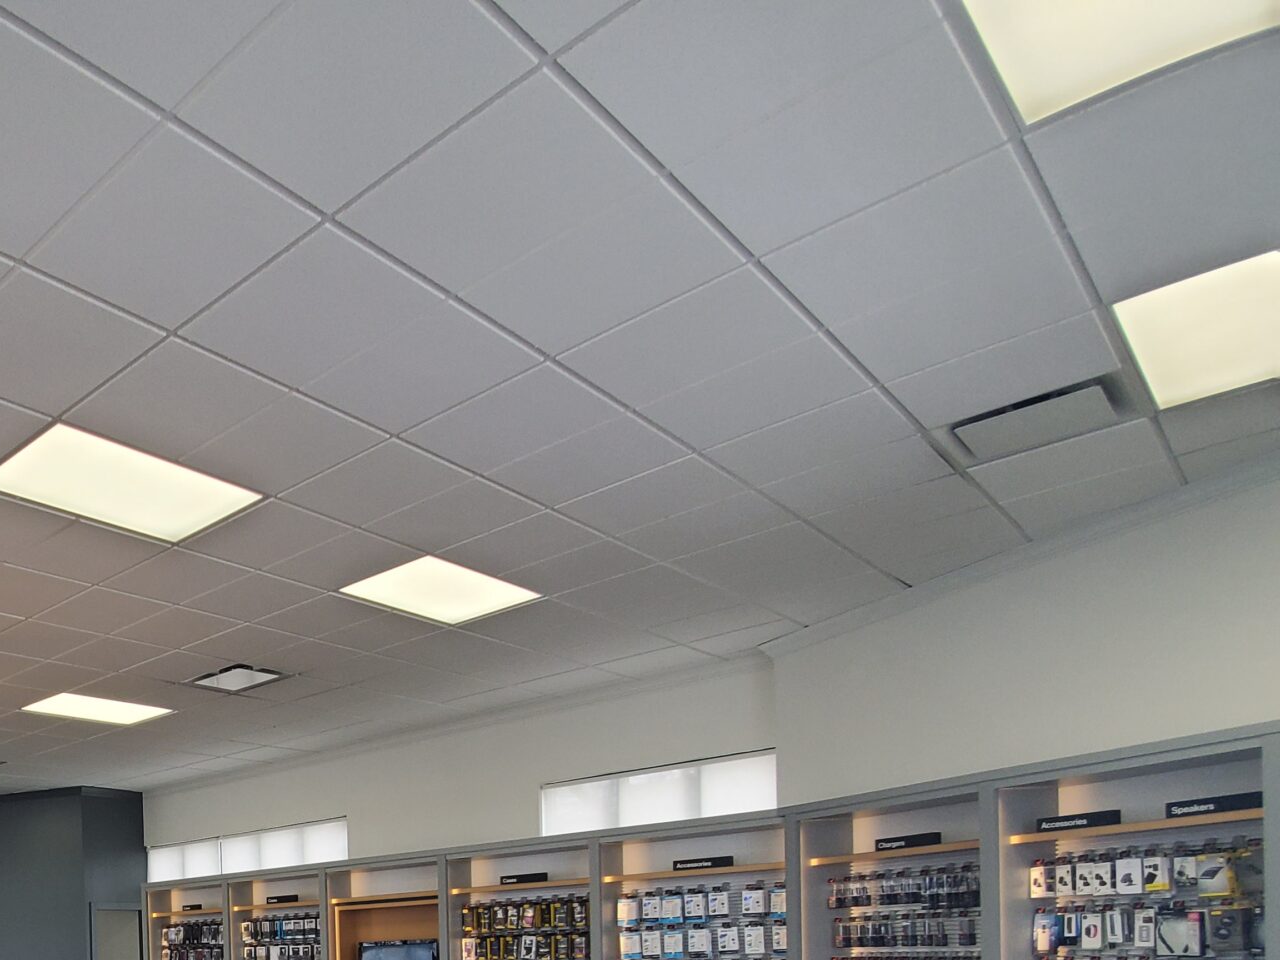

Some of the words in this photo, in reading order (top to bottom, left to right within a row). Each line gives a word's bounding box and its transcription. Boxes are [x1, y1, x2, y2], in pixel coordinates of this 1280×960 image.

[1171, 804, 1214, 815] Speakers
[1041, 818, 1087, 829] Accessories
[676, 861, 712, 869] Accessories
